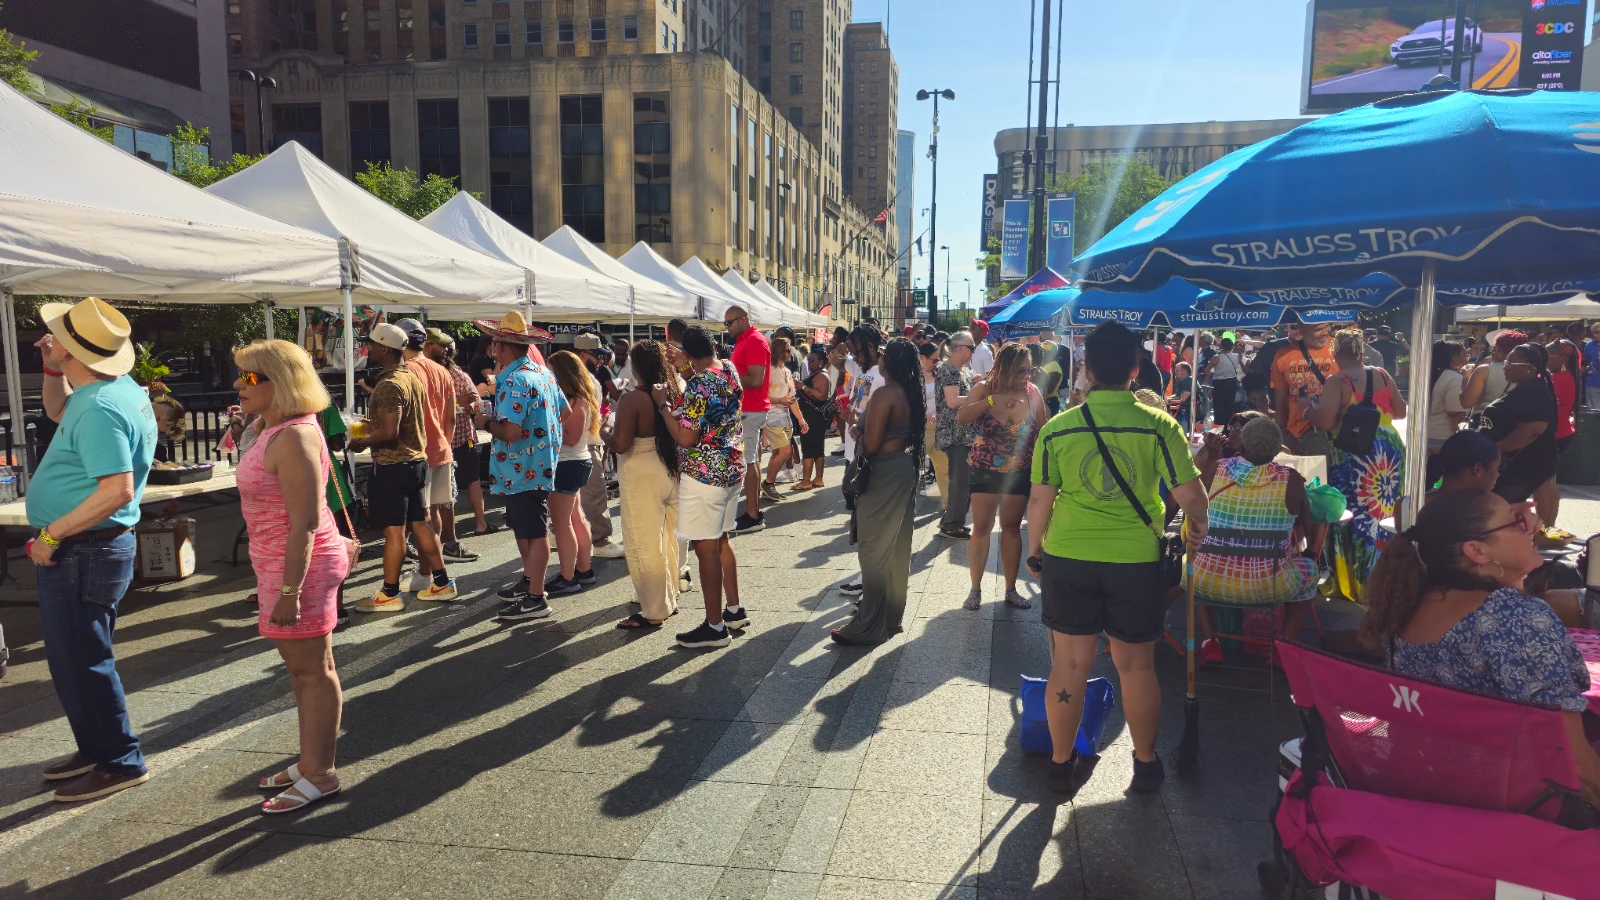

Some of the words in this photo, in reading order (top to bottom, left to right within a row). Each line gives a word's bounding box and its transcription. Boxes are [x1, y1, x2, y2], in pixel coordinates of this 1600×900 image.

[1535, 22, 1574, 35] 3CDC
[1532, 50, 1572, 60] altafiber
[985, 179, 997, 217] DMG
[1211, 232, 1357, 265] STRAUSS
[1259, 288, 1332, 304] STRAUSS
[1079, 308, 1117, 320] STRAUSS
[1118, 309, 1144, 321] TROY
[1180, 310, 1269, 323] strausstroy.com
